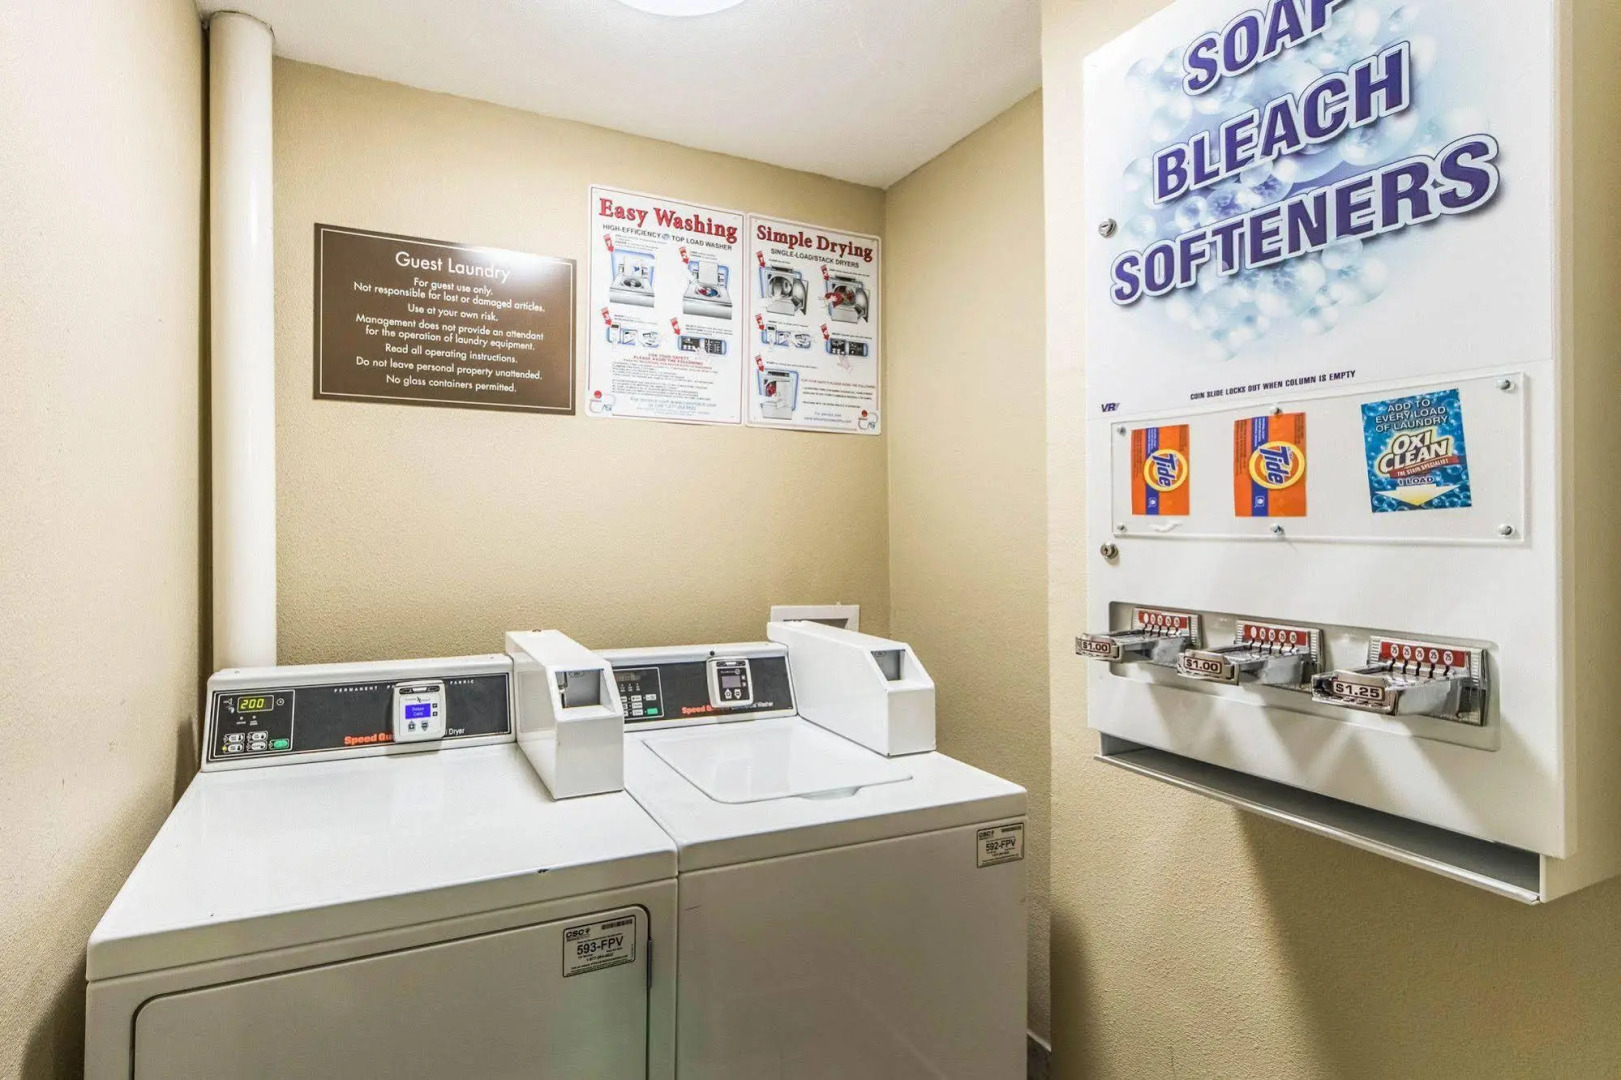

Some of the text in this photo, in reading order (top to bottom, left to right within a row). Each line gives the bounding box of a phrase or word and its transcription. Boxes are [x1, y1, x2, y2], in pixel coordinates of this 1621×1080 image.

[1155, 44, 1407, 201] BLEACH
[599, 198, 648, 228] Easy
[653, 208, 738, 244] Washing
[1112, 136, 1496, 303] SOFTENERS
[602, 224, 661, 238] HIGH-EFFICIENCY
[686, 238, 704, 246] LOAD
[705, 240, 732, 250] WASHER
[757, 225, 872, 262] Simple Drying
[396, 251, 511, 283] Guest Laundry
[770, 248, 834, 264] SINGLE-LOAD/STACK
[836, 259, 860, 268] DRYERS
[414, 278, 493, 296] For guest use only.
[354, 282, 372, 292] Not
[374, 285, 426, 299] responsible
[428, 290, 442, 300] for
[444, 292, 458, 302] lost
[472, 295, 512, 310] damaged
[514, 300, 546, 312] articles.
[408, 304, 499, 322] Use at your own risk.
[356, 314, 544, 340] Management does not provide an attendant
[366, 326, 534, 351] for the operation of laundry equipment.
[386, 344, 518, 364] Read all operating instructions.
[356, 356, 543, 380] Do not leave personal property unattended.
[386, 374, 517, 393] No glass containers permitted.
[1190, 370, 1356, 400] COIN SLIDE LOCKS OUT WHEN COLUMN IS EMPTY
[1375, 406, 1446, 424] EVERY LOAD
[1388, 399, 1430, 413] ADD TO
[1376, 416, 1448, 433] OF LAUNDRY
[1392, 430, 1432, 455] OXI
[1258, 446, 1290, 484] Tide
[1378, 438, 1449, 474] CLEAN
[1152, 453, 1176, 487] Tide
[1406, 476, 1435, 486] LOAD
[1082, 641, 1108, 652] $1.00
[1186, 660, 1218, 672] $1.00
[1336, 683, 1380, 698] $1.25
[240, 699, 264, 709] 200
[682, 705, 705, 715] Speed
[344, 734, 377, 745] Speed
[449, 728, 464, 736] Dryer
[986, 838, 1016, 851] 592-FPV
[566, 929, 585, 938] CSC
[577, 936, 624, 955] 593-FPV
